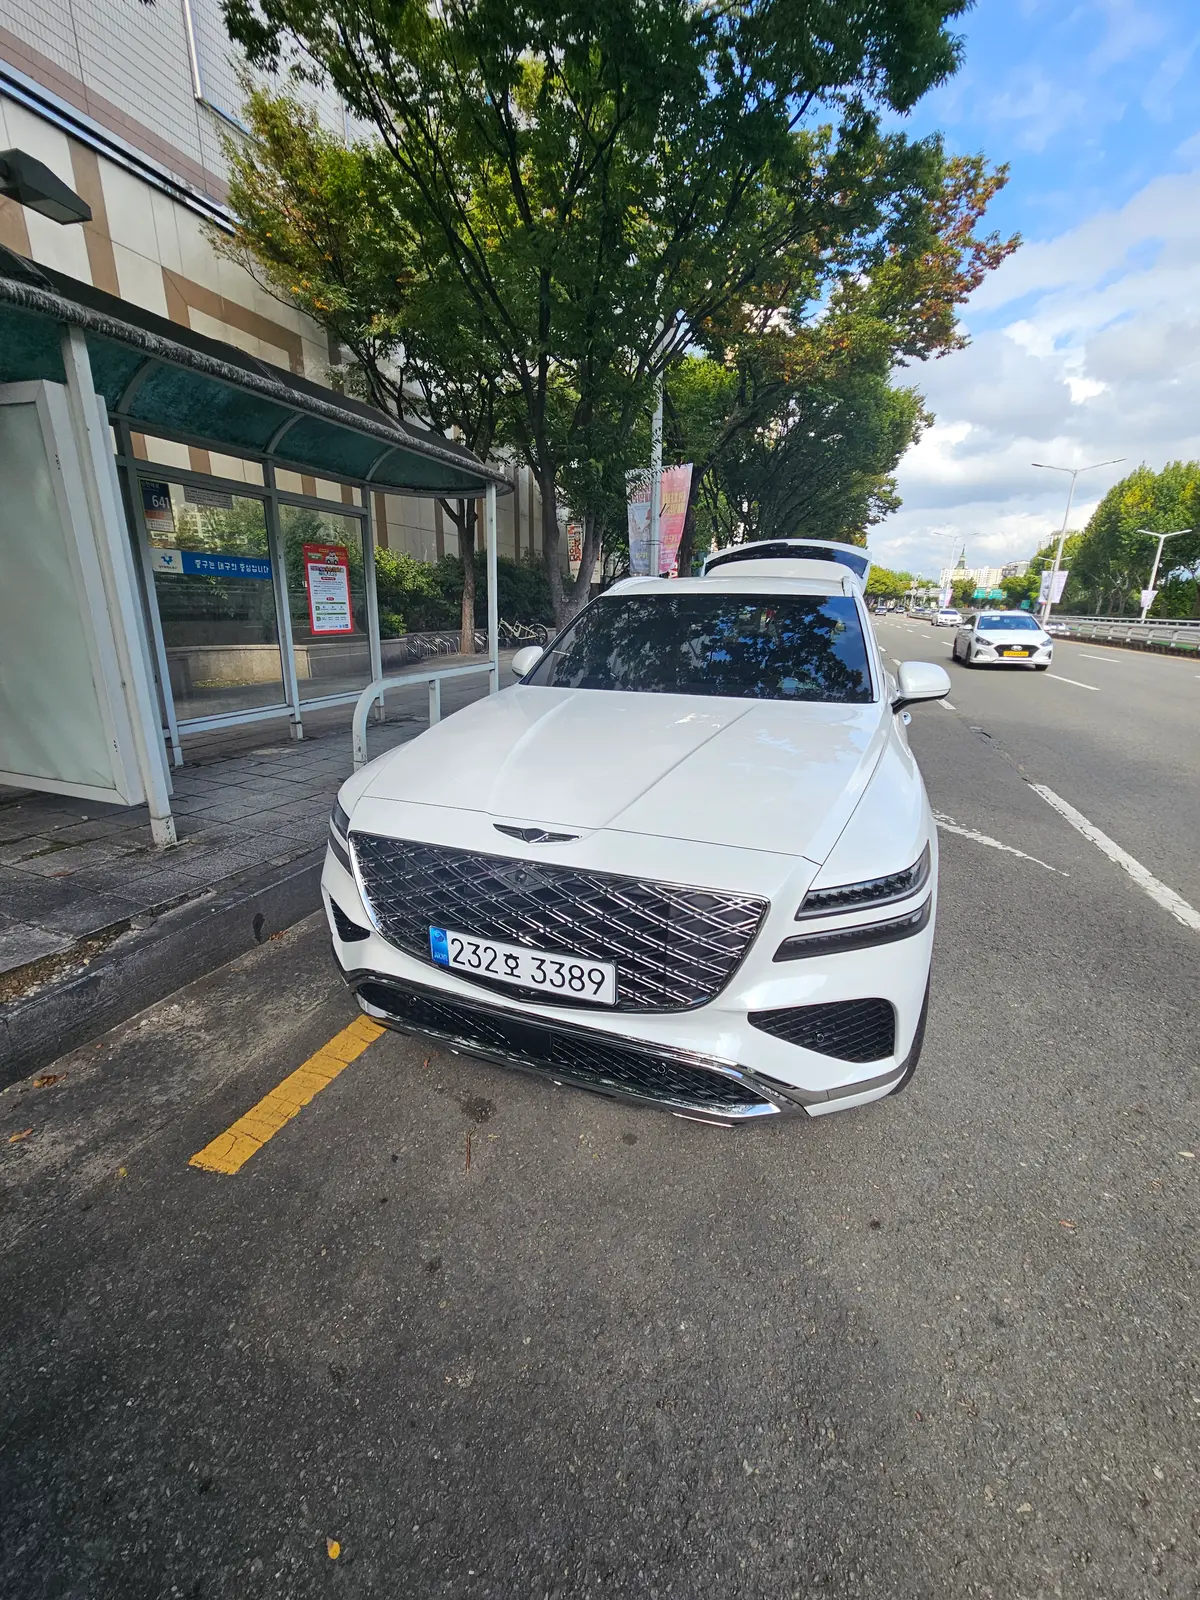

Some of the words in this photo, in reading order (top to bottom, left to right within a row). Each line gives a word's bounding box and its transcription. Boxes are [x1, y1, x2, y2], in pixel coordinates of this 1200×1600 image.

[151, 494, 170, 509] 641
[194, 559, 215, 570] 중구는
[217, 561, 238, 571] 대구의
[239, 563, 269, 574] 중심입니다
[451, 937, 521, 978] 232호
[530, 956, 606, 995] 3389
